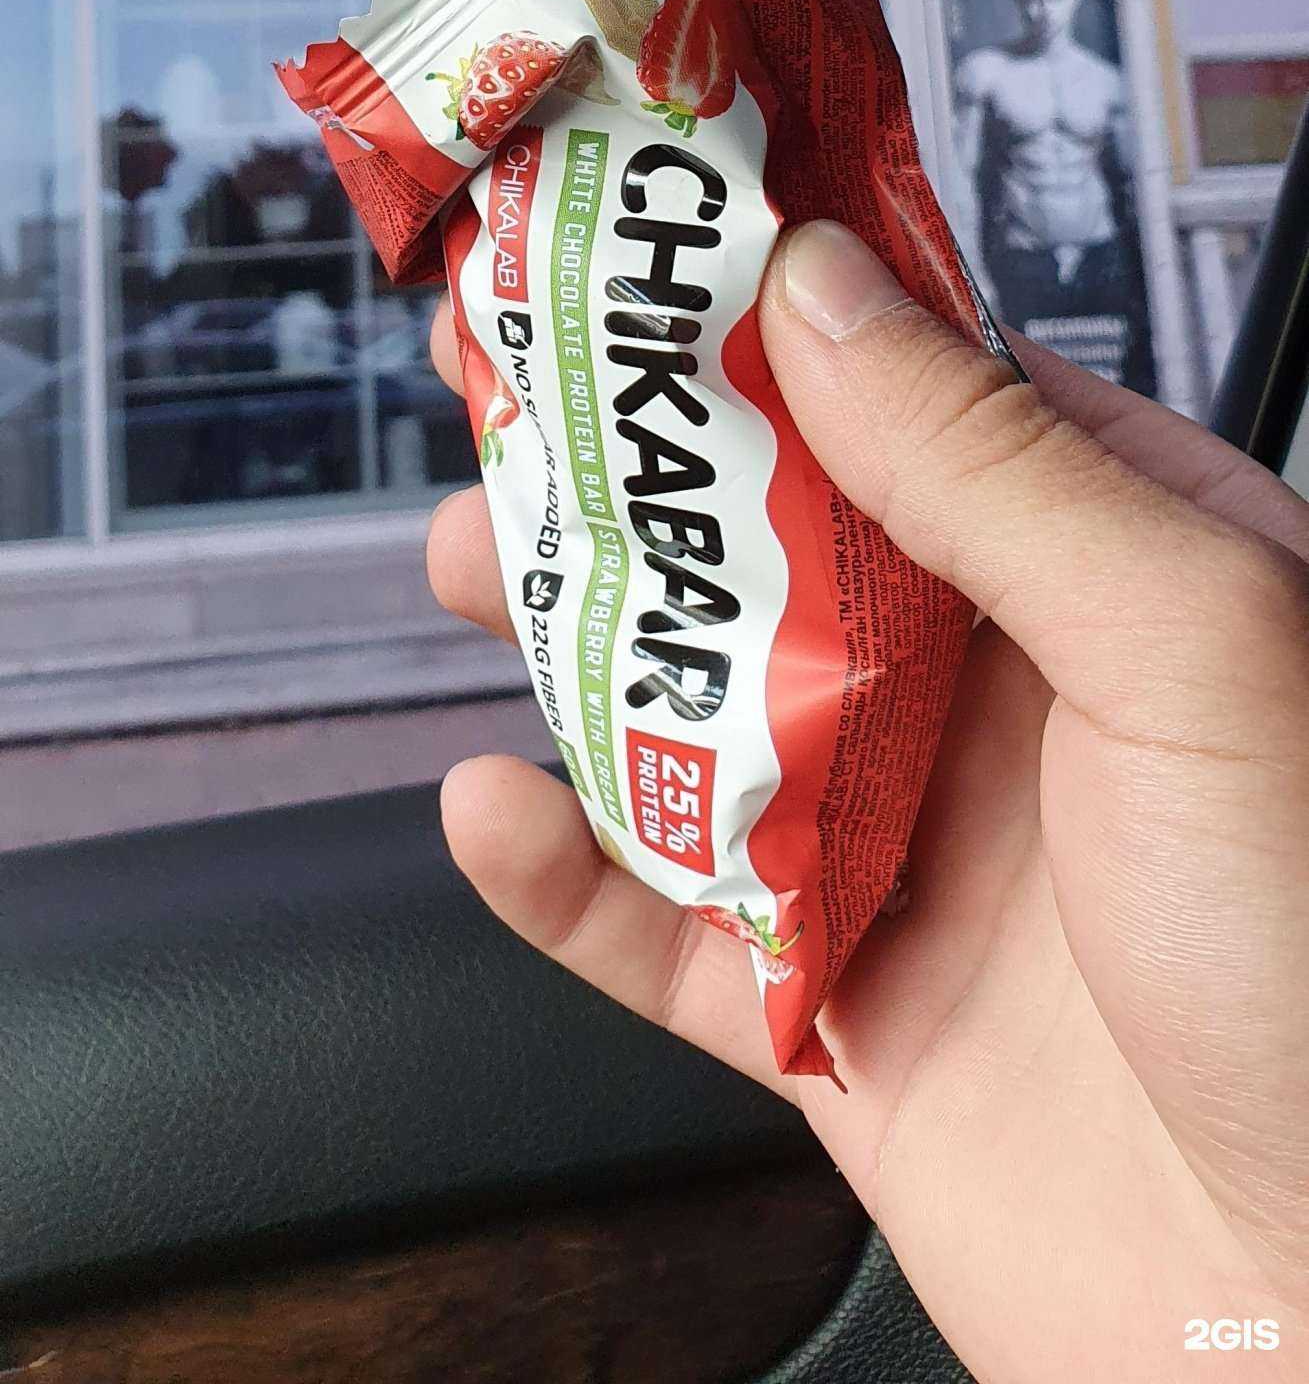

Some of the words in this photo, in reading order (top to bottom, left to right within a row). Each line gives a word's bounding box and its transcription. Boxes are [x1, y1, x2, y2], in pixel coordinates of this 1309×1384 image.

[568, 141, 601, 213] WHITE
[495, 143, 532, 289] CHIKALAB
[559, 221, 588, 360] CHOCOLATE
[510, 353, 532, 393] NO
[566, 367, 599, 464] PROTEIN
[603, 143, 741, 721] CHIKABAR
[580, 472, 607, 512] BAR
[531, 614, 551, 666] 22G
[584, 528, 622, 681] STRAWBERRY
[538, 668, 564, 732] FIBER
[586, 690, 608, 746] WITH
[838, 714, 851, 732] со
[594, 750, 620, 820] CREAM
[636, 744, 662, 845] PROTEIN
[661, 753, 702, 856] 25%
